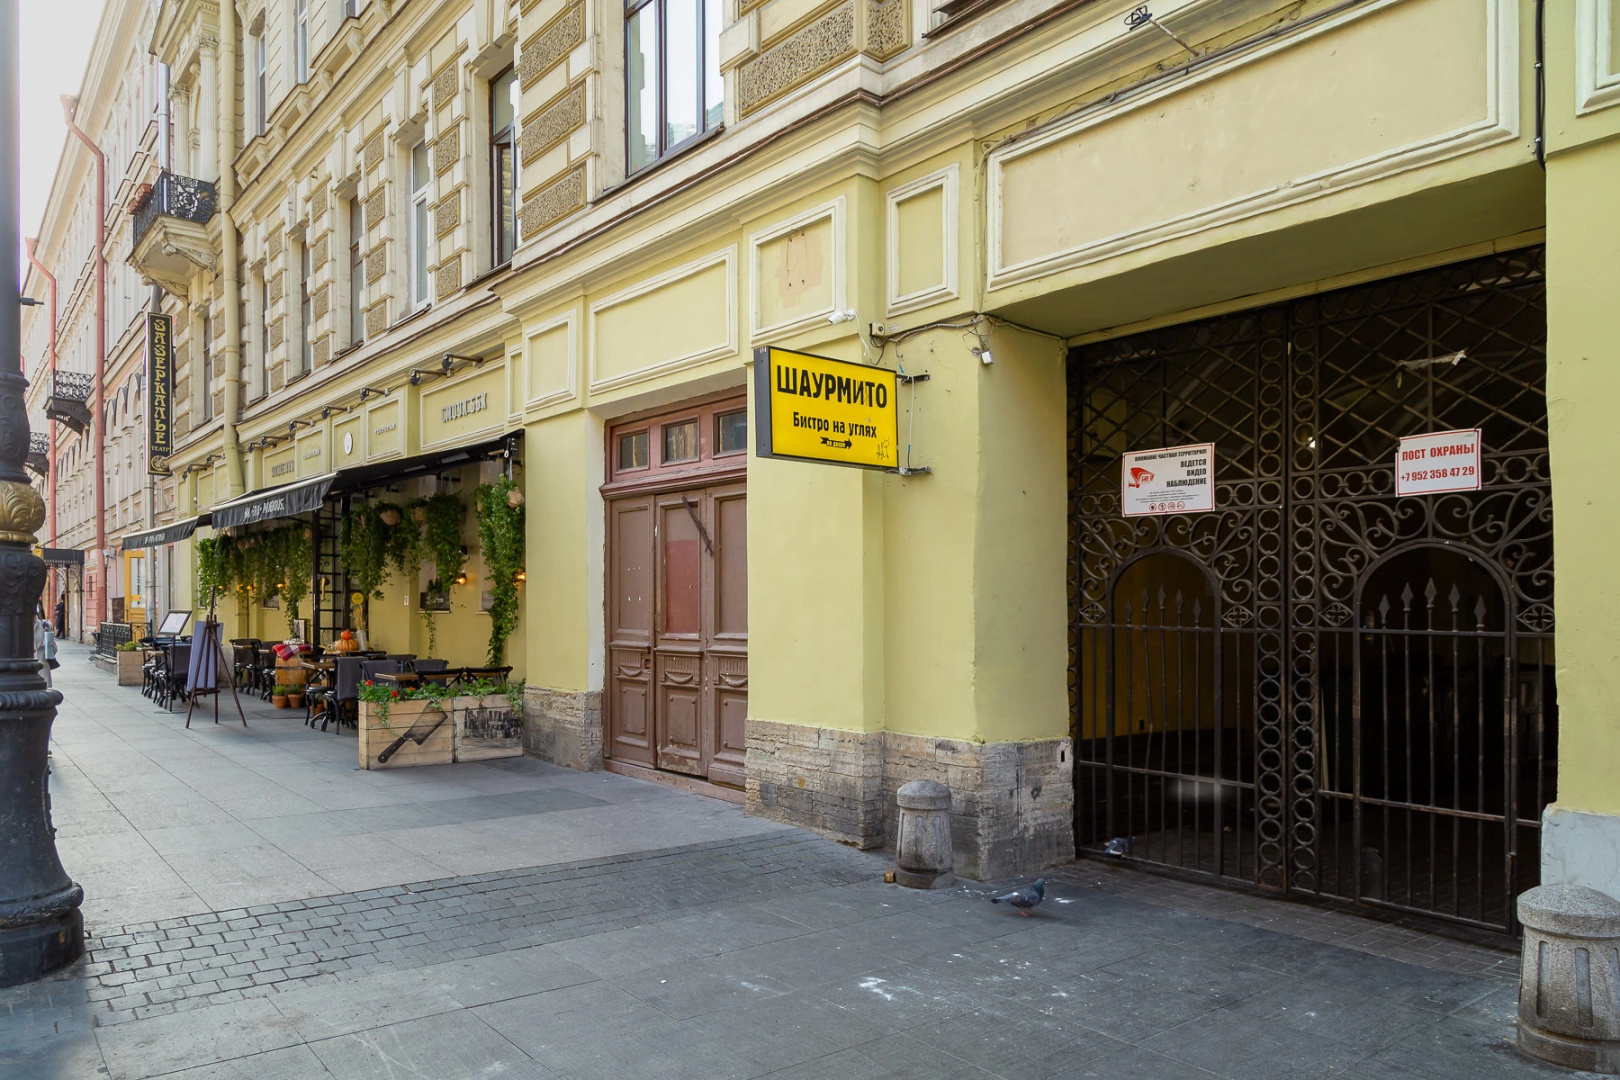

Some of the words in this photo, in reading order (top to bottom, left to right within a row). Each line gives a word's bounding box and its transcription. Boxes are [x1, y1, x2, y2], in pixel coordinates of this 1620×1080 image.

[154, 319, 166, 444] ЗАЗЕРКАЛЬЕ
[777, 365, 887, 408] ШАУРМИТО
[793, 411, 829, 432] Бистро
[833, 420, 845, 433] на
[849, 422, 877, 438] углях
[1402, 449, 1426, 461] ПОСТ
[1430, 443, 1474, 457] ОХРАНЫ
[1181, 459, 1207, 468] ВЕДЕТСЯ
[1187, 468, 1207, 476] ВИДЕО
[1401, 472, 1410, 481] +7
[1412, 470, 1427, 481] 952
[1430, 468, 1447, 479] 358
[1450, 467, 1460, 477] 47
[1462, 466, 1474, 476] 29
[1166, 478, 1207, 487] НАБЛЮДЕНИЕ
